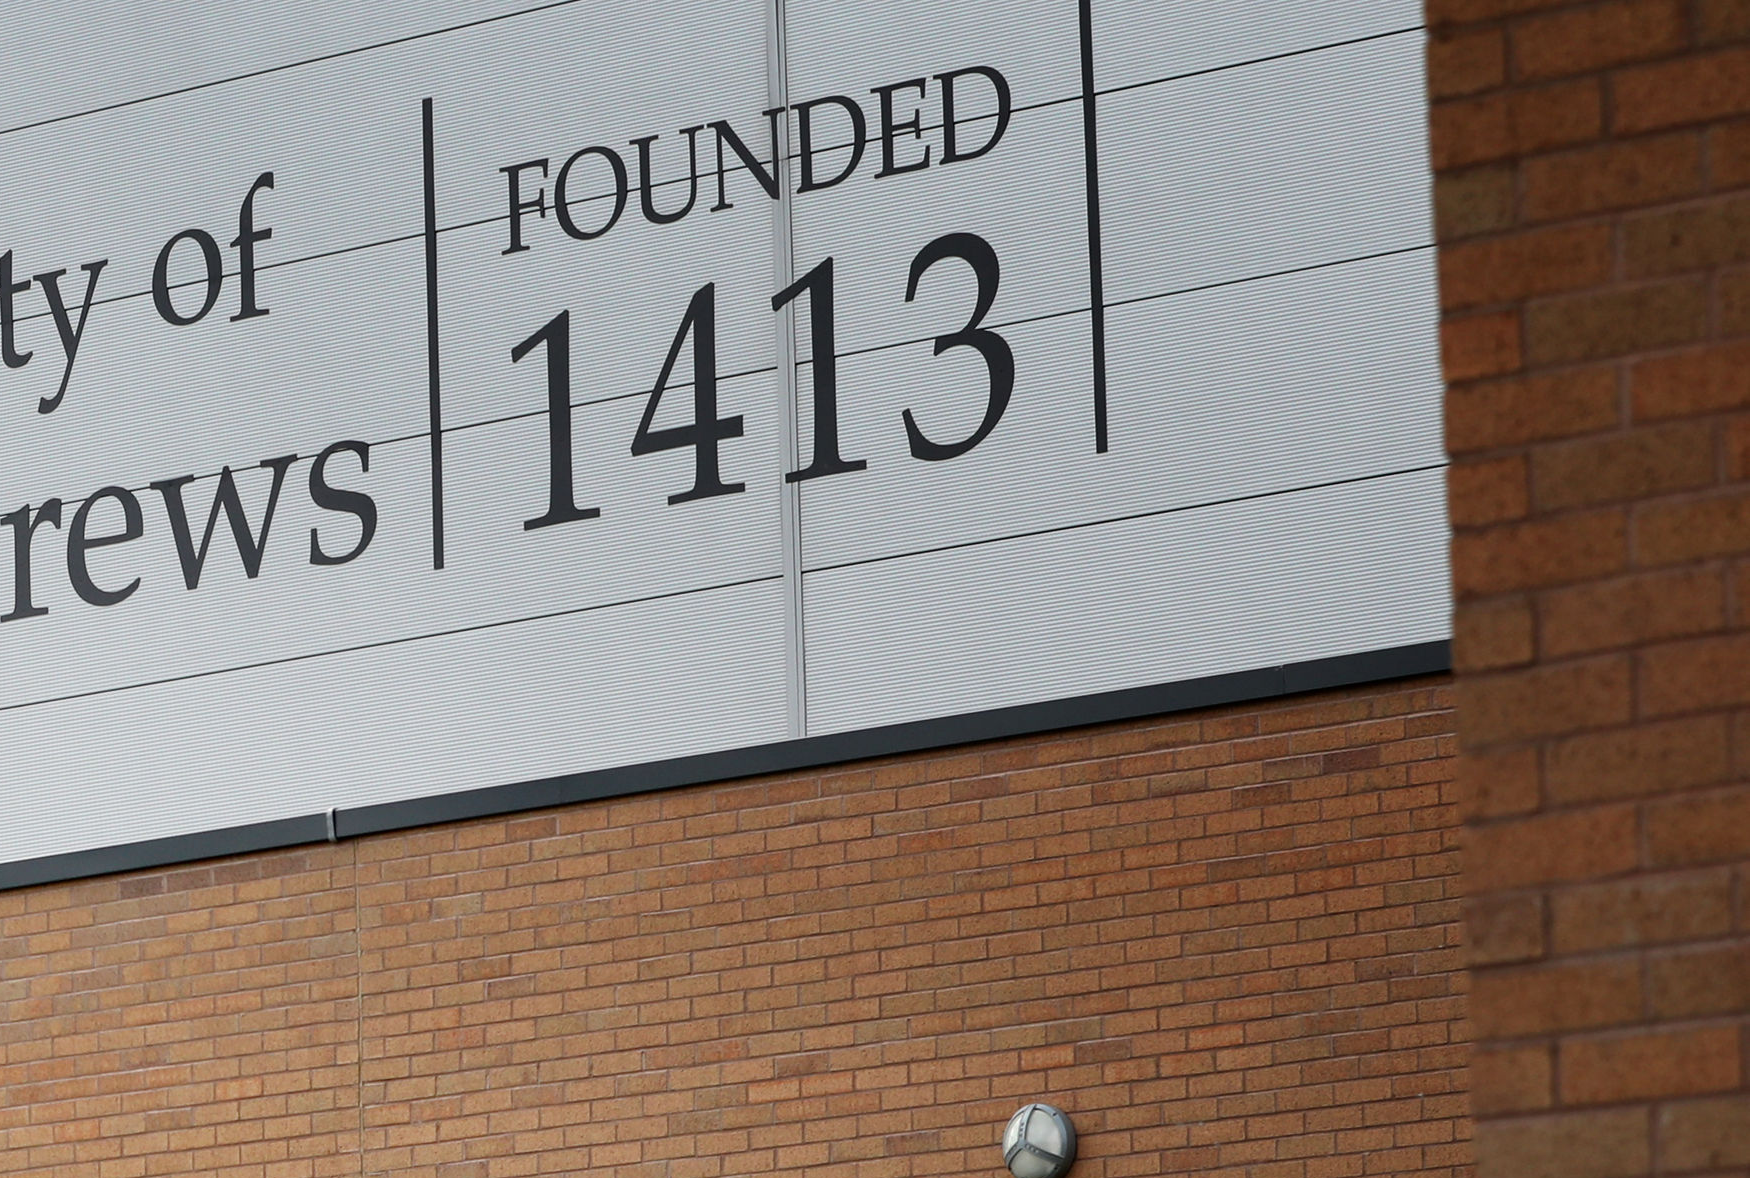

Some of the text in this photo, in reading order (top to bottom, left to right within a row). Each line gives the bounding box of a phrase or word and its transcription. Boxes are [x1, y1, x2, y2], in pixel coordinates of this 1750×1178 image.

[151, 171, 278, 328] of
[501, 65, 1014, 256] FOUNDED
[509, 232, 1017, 532] 1413
